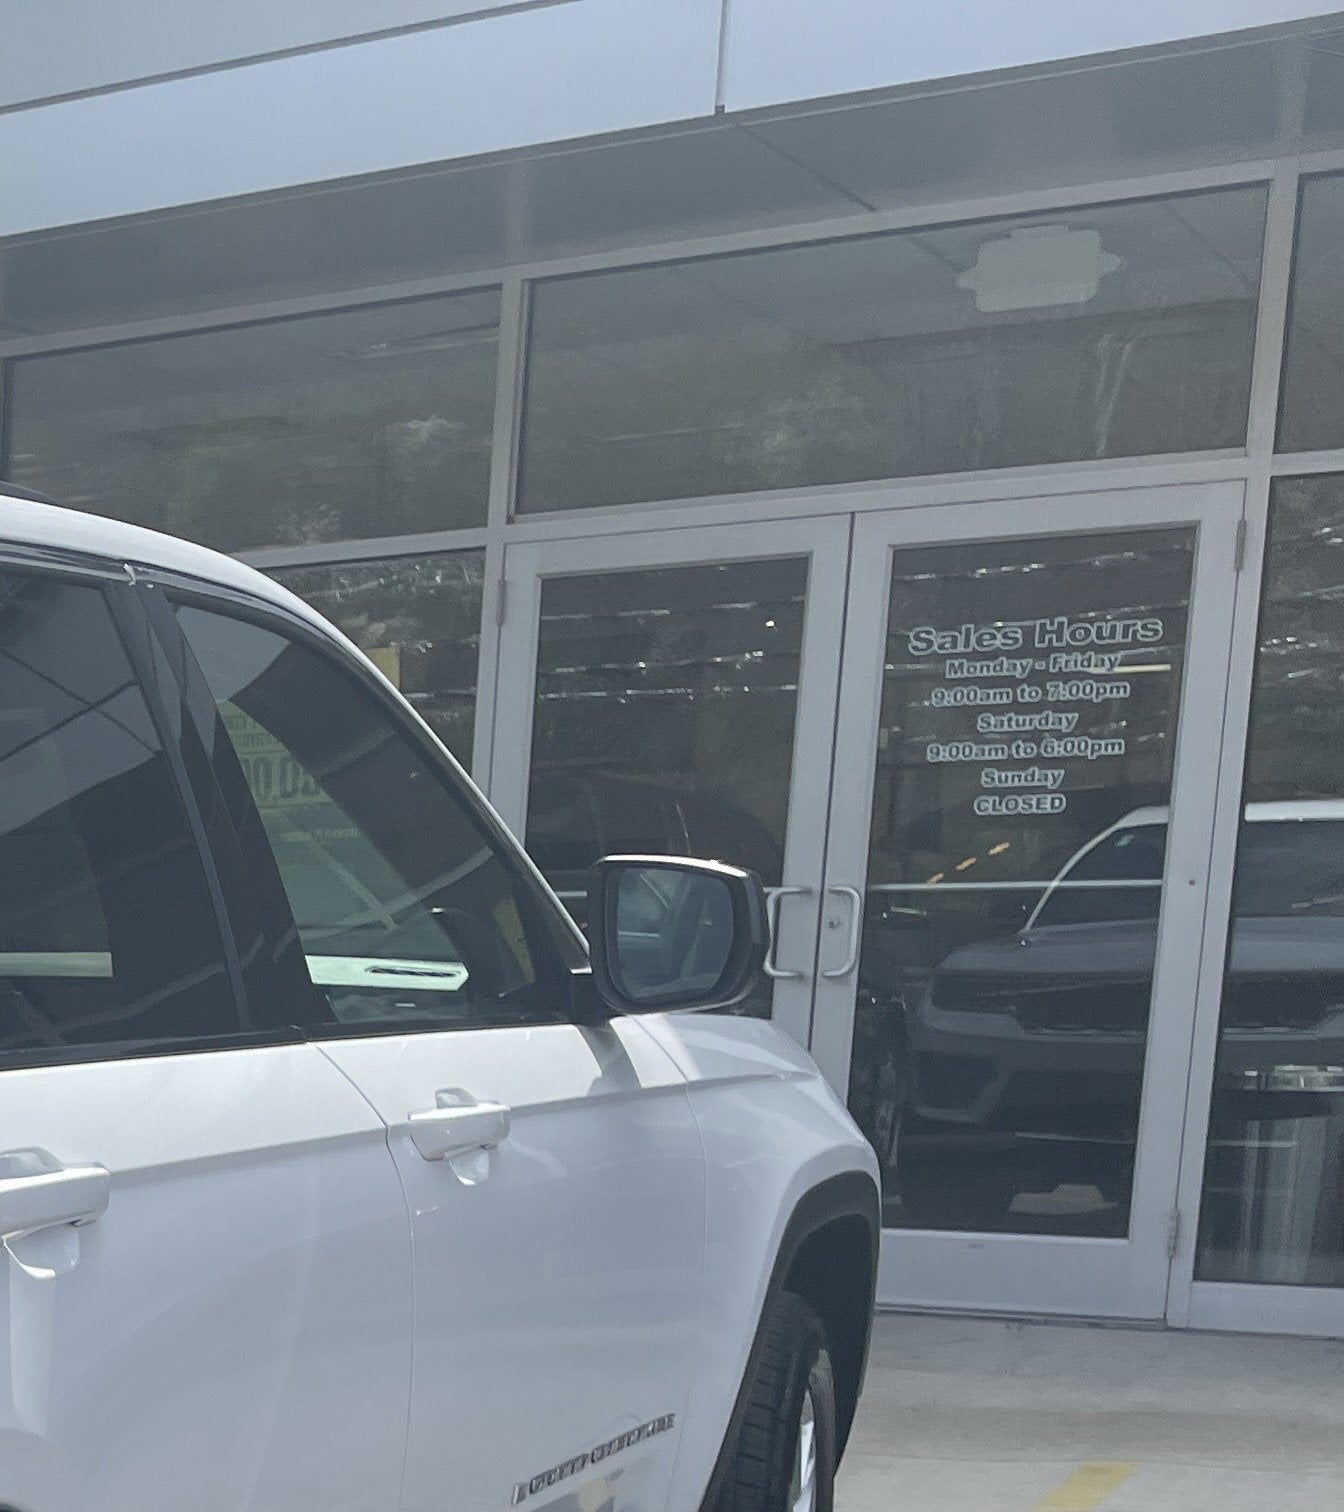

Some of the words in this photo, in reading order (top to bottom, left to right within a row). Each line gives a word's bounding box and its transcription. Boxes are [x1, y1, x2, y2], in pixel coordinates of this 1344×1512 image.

[908, 624, 1022, 655] Sales
[1034, 617, 1163, 648] Hours
[945, 656, 1033, 678] Monday
[1049, 652, 1121, 673] Friday
[930, 687, 1013, 707] 9:00am
[1016, 684, 1042, 702] to
[1046, 681, 1130, 702] 7:00pm
[976, 710, 1079, 732] Saturday
[926, 742, 1008, 762] 9:00am
[1012, 740, 1037, 758] to
[1040, 738, 1125, 760] 6:00pm
[980, 766, 1065, 789] Sunday
[973, 793, 1066, 816] CLOSED
